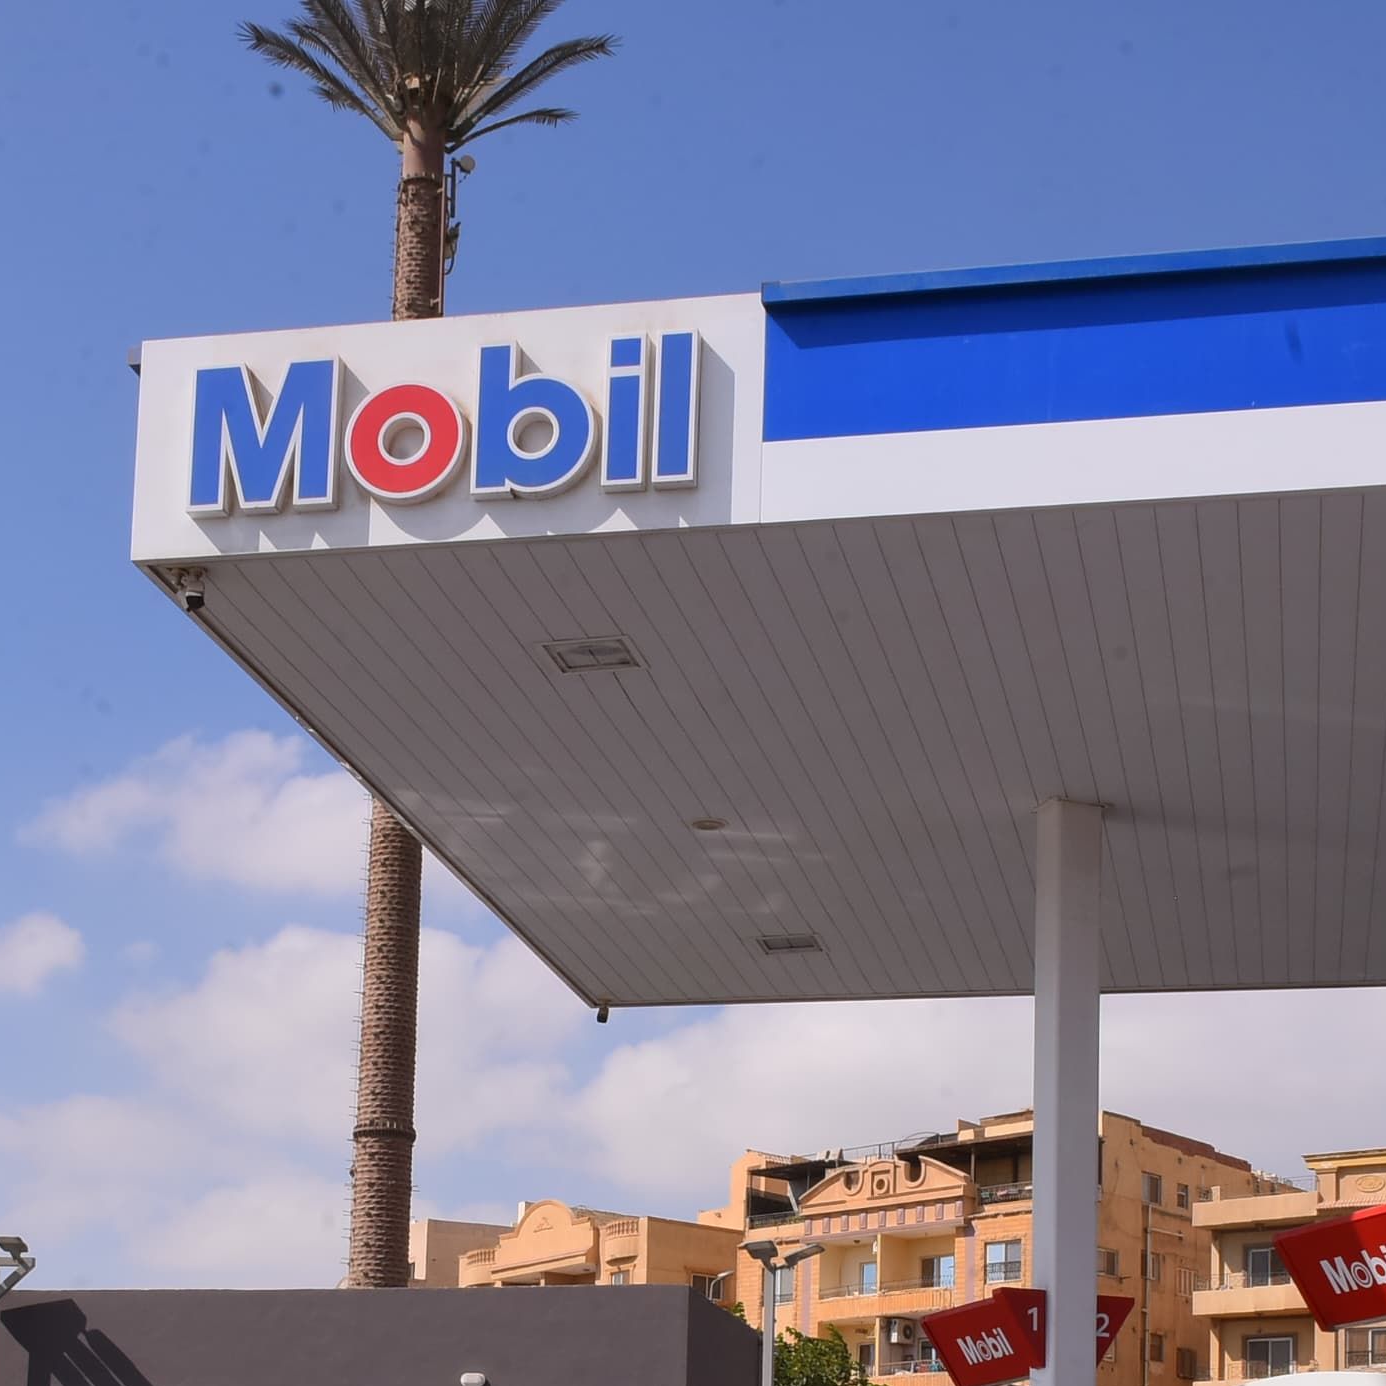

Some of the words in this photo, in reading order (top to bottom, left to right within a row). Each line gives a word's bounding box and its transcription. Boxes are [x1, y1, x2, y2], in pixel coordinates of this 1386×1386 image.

[186, 329, 701, 518] Mobil
[1027, 1307, 1039, 1332] 1
[1096, 1313, 1110, 1338] 2
[957, 1327, 1014, 1366] Mobil
